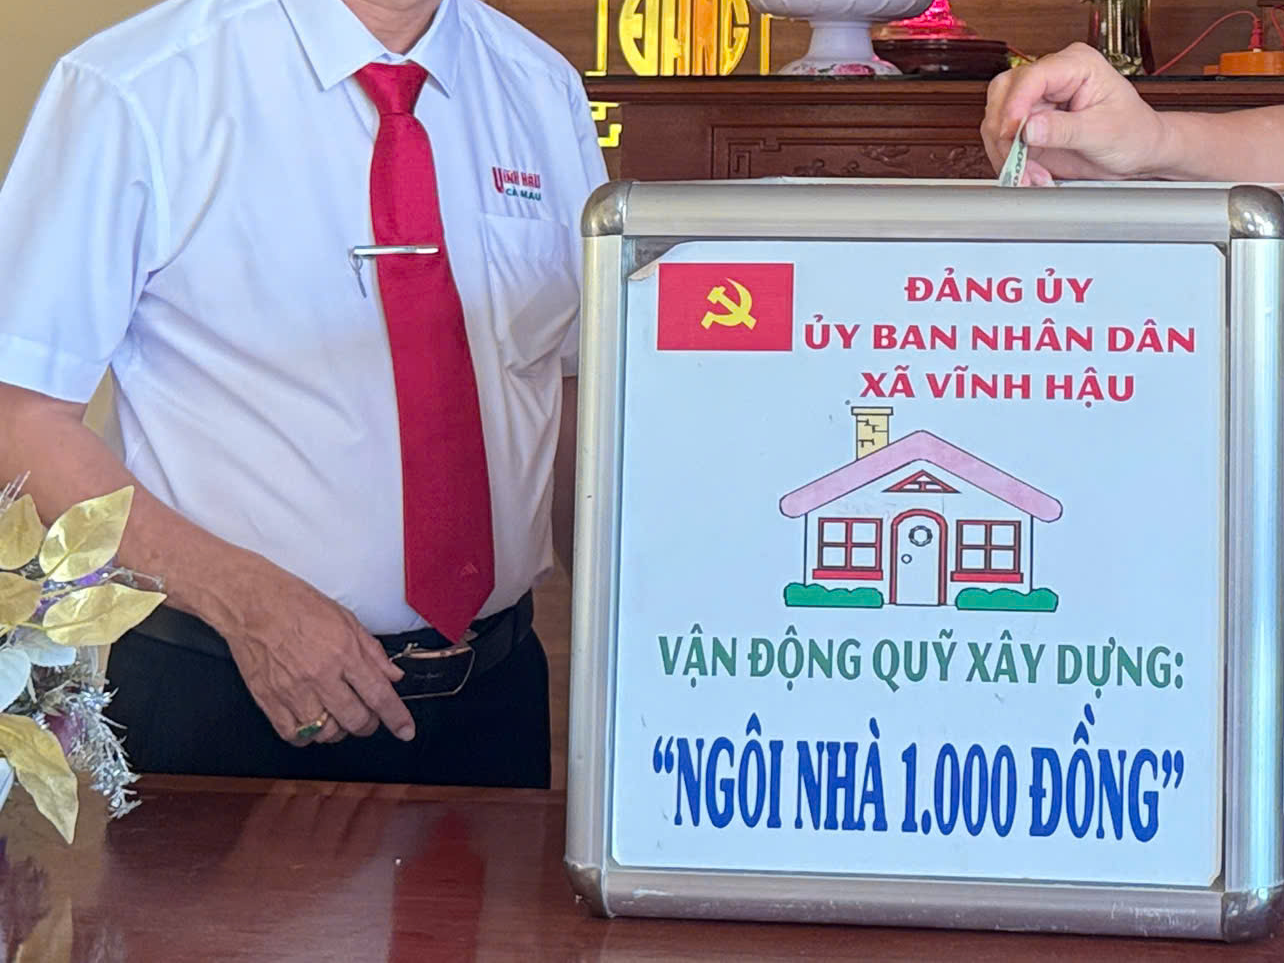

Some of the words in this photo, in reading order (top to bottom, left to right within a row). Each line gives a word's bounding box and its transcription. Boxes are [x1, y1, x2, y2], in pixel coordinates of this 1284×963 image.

[904, 267, 1024, 304] ĐẢNG
[1036, 267, 1094, 304] ỦY
[804, 314, 861, 351] ỦY
[873, 323, 958, 352] BAN
[971, 318, 1095, 353] NHÂN
[1107, 318, 1196, 354] DÂN
[860, 365, 916, 399] XÃ
[925, 365, 1032, 400] VĨNH
[1045, 366, 1136, 408] HẬU
[658, 623, 738, 689] VẬN
[748, 625, 862, 691] ĐỘNG
[871, 628, 957, 692] QUỸ
[965, 629, 1046, 686] XÂY
[1056, 637, 1185, 699] DỰNG:
[793, 717, 889, 833] NHÀ
[900, 742, 1018, 837] 1.000
